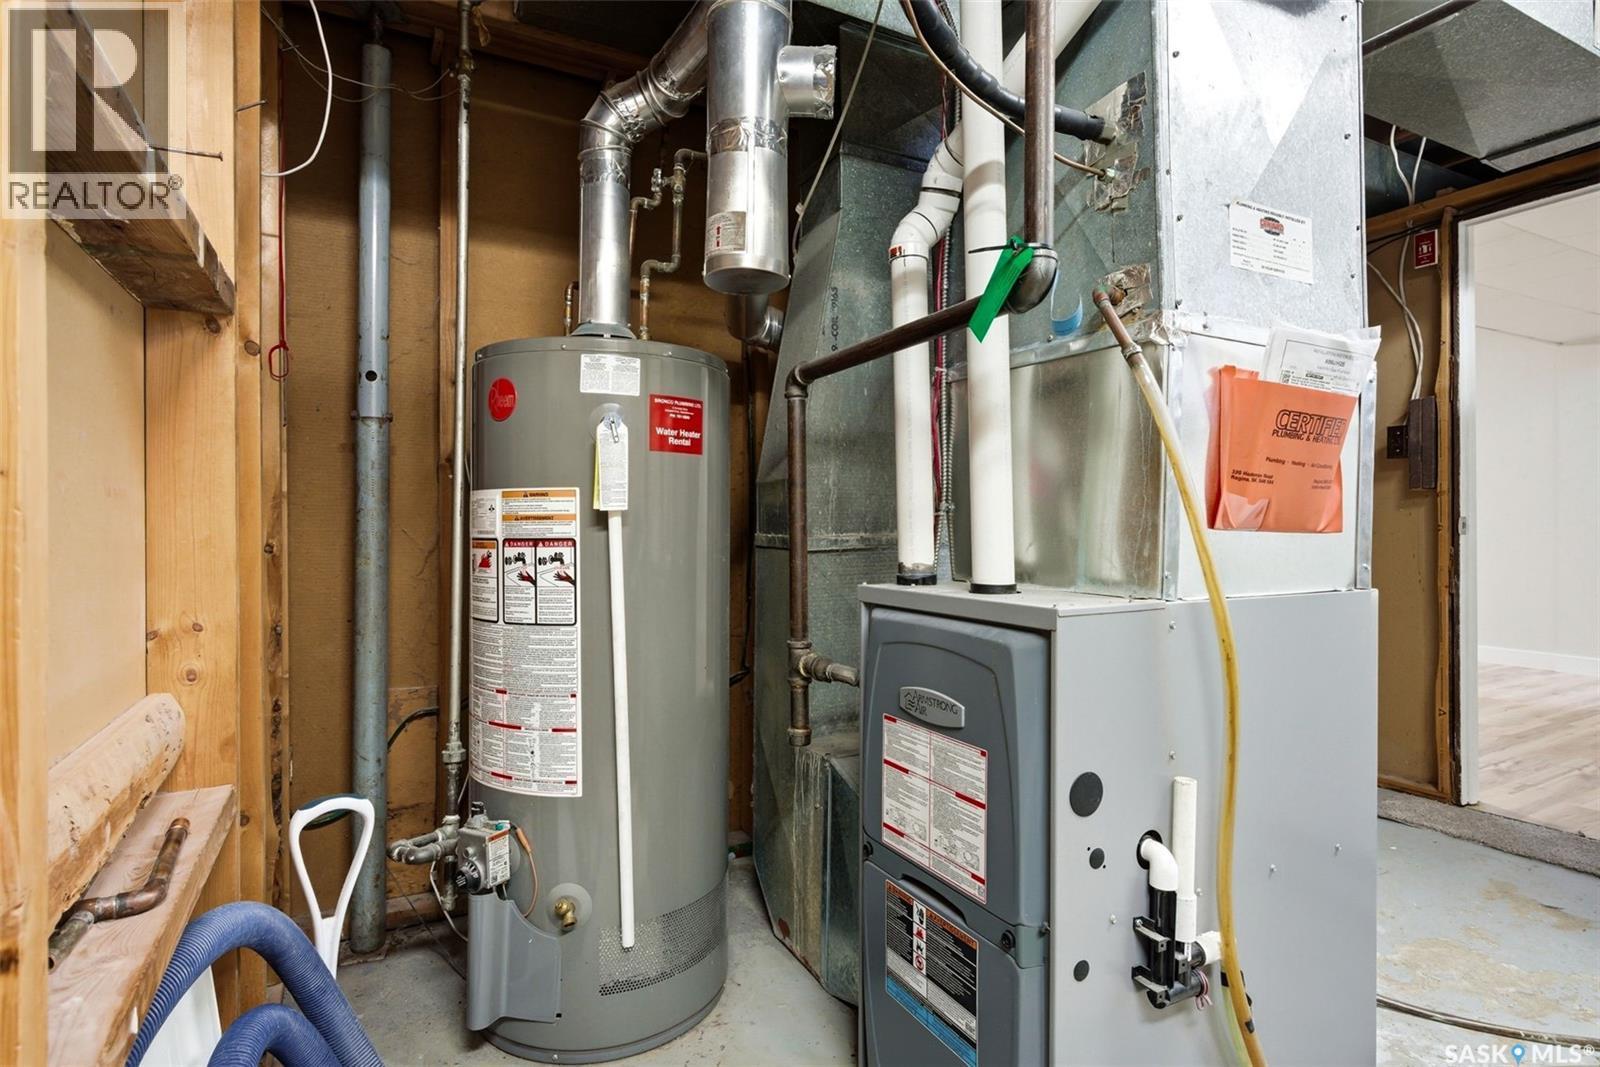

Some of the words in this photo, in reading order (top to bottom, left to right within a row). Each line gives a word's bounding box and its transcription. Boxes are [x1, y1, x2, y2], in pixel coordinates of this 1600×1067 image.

[1275, 408, 1347, 439] CERTIFIE
[655, 427, 678, 436] Water
[680, 429, 701, 439] Heater
[1271, 429, 1305, 441] PLUMBING
[668, 438, 691, 446] Rental
[912, 689, 959, 715] ARMSTRONG
